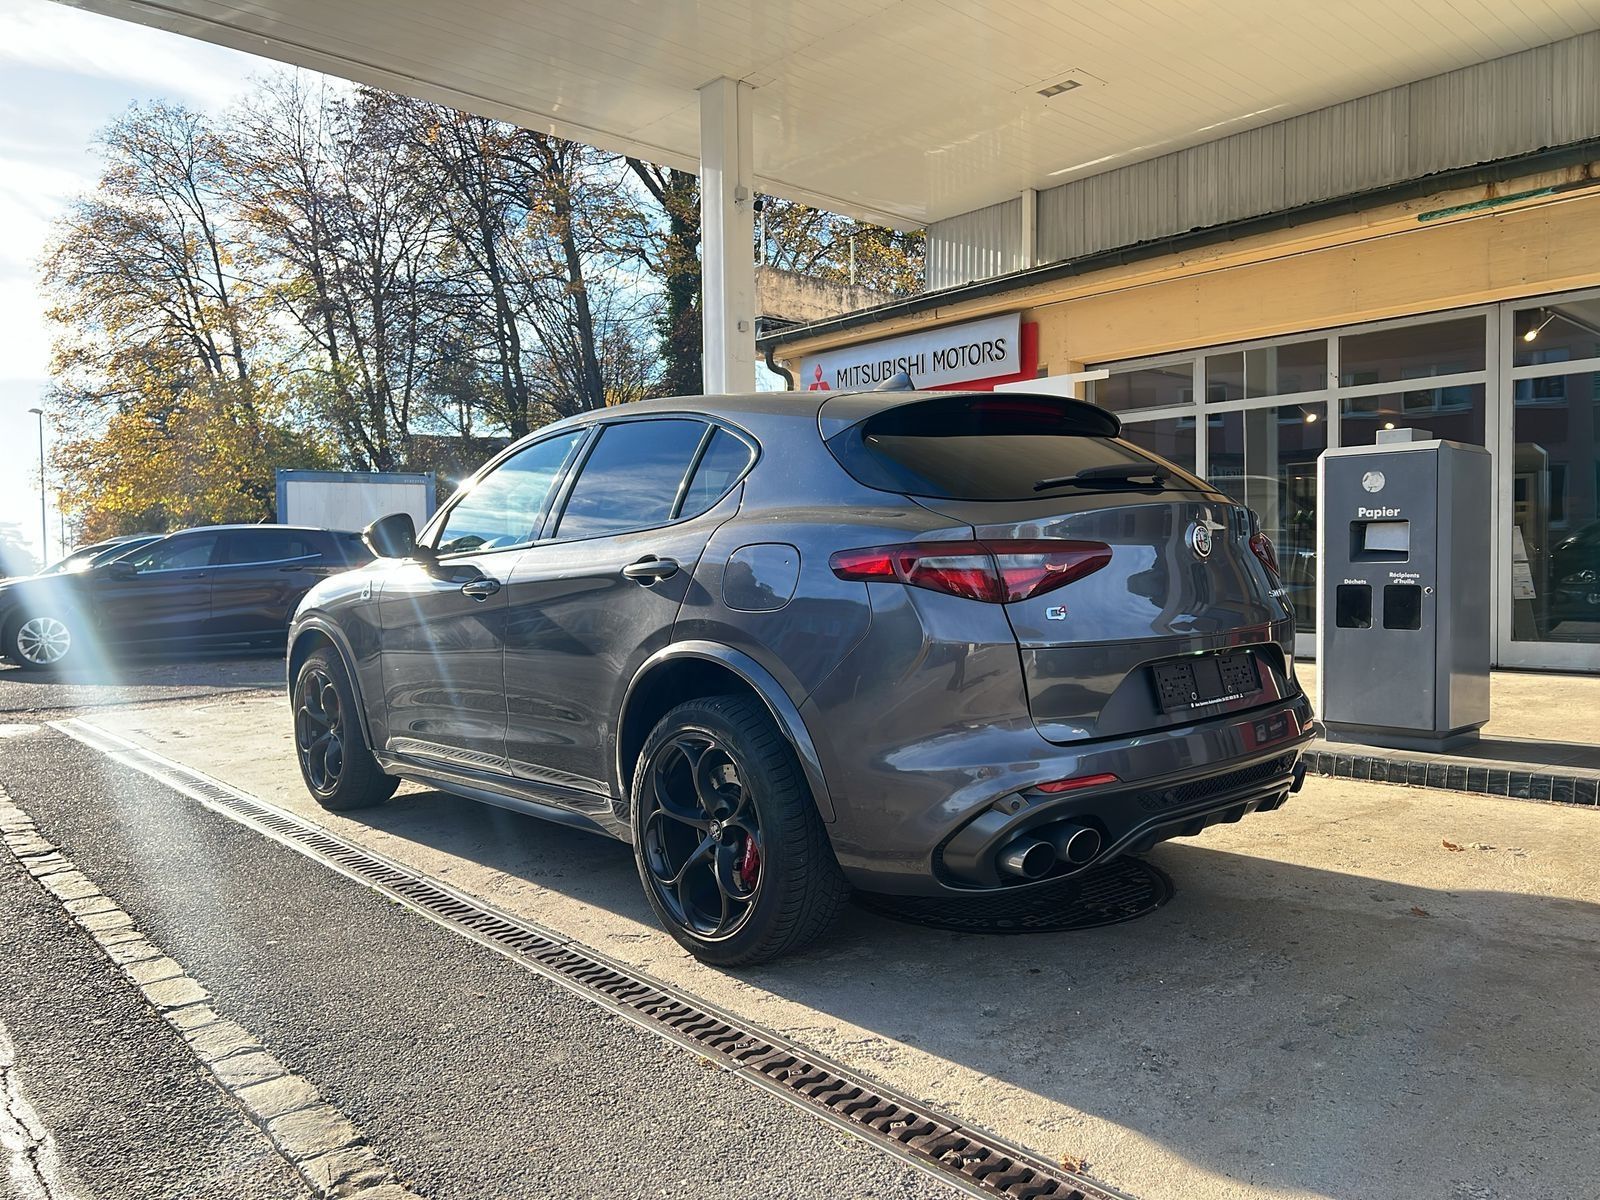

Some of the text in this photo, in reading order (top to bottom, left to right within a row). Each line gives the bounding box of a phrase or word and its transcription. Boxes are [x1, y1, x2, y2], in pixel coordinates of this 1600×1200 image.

[836, 338, 1007, 389] MITSUBISHI MOTORS
[1358, 507, 1401, 519] Papier
